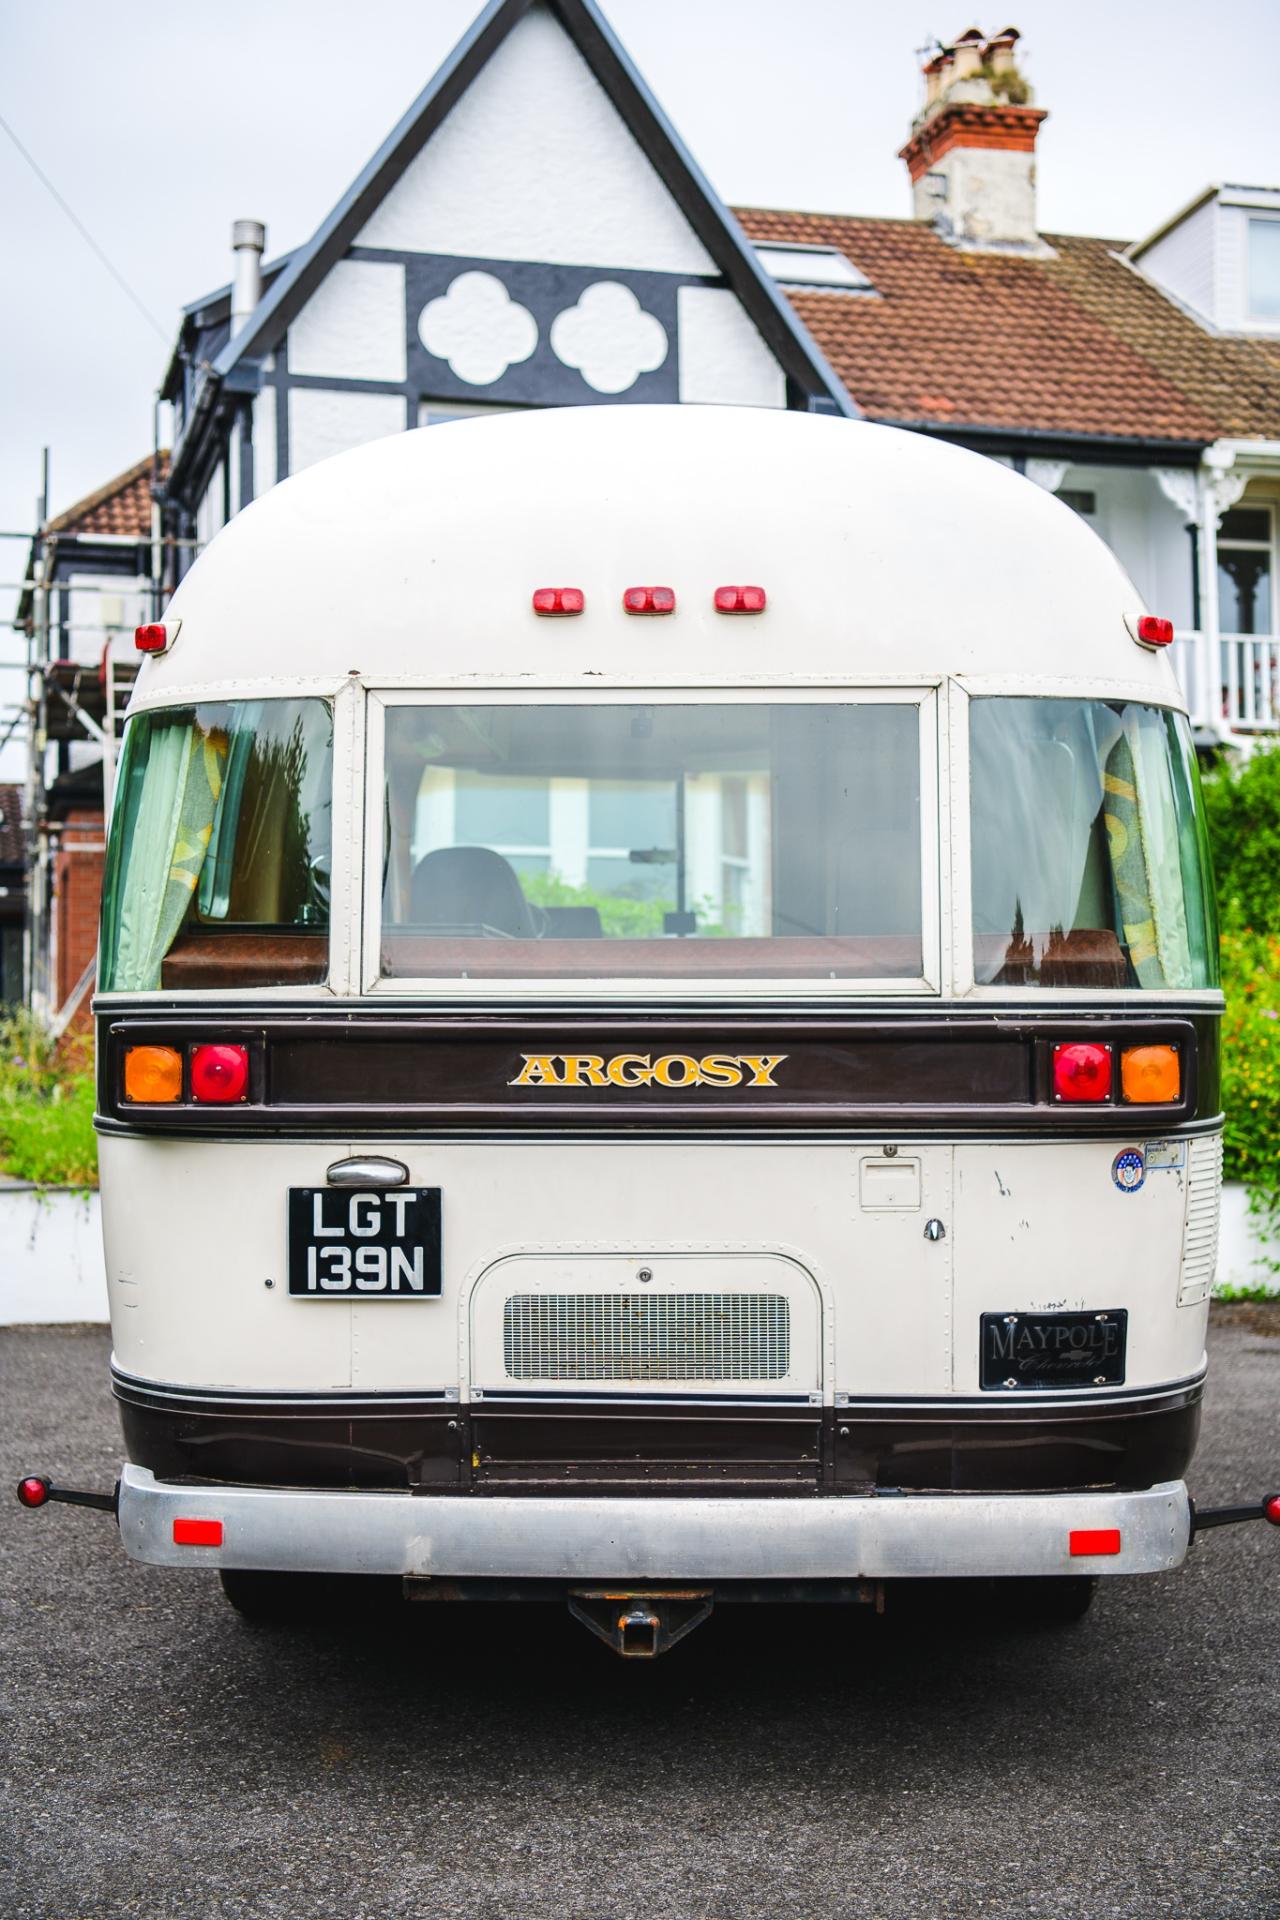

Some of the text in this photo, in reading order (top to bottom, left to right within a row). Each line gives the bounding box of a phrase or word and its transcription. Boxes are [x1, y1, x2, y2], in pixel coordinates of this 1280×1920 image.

[506, 1053, 789, 1088] ARGOSY
[313, 1192, 417, 1237] LGT
[307, 1246, 424, 1291] 139N
[989, 1322, 1119, 1361] MAYPOLE
